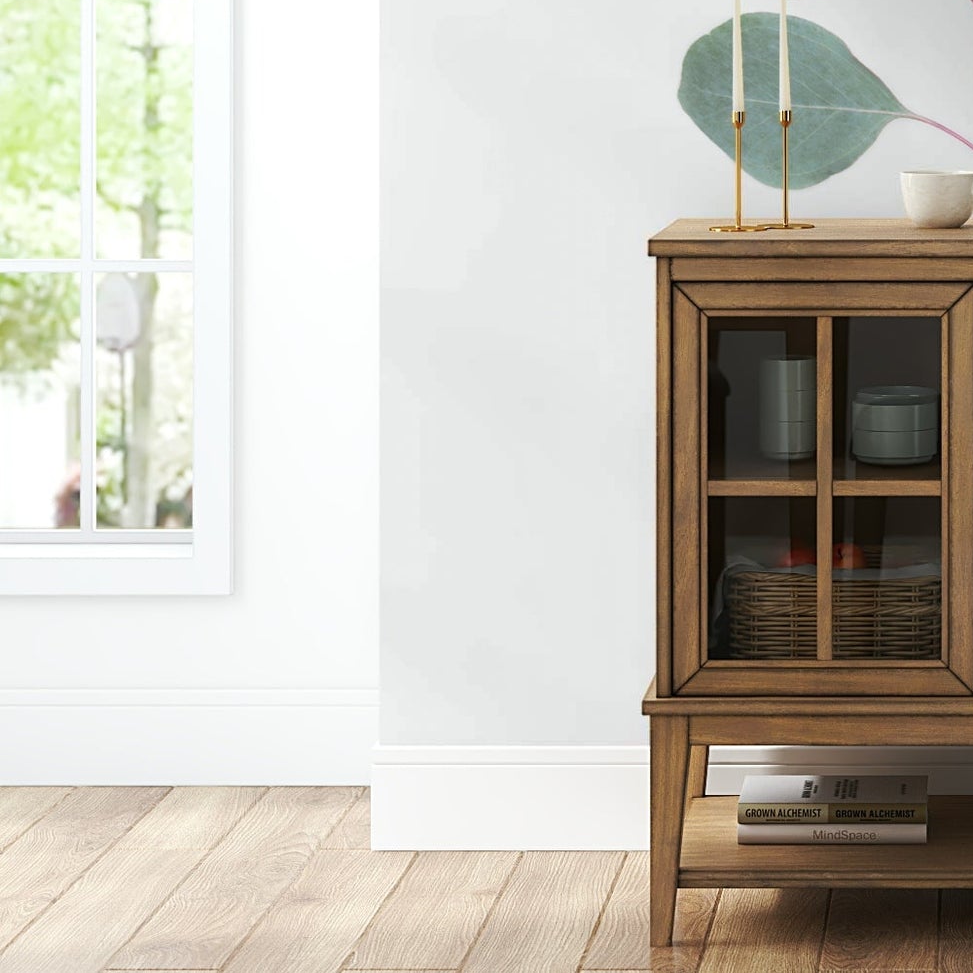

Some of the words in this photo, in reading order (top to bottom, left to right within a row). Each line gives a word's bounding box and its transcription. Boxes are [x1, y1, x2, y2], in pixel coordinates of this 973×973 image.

[745, 808, 777, 818] GROWN
[777, 808, 822, 818] ALCHEMIST
[835, 809, 867, 818] GROWN
[869, 809, 916, 818] ALCHEMIST
[812, 830, 876, 842] MindSpace
